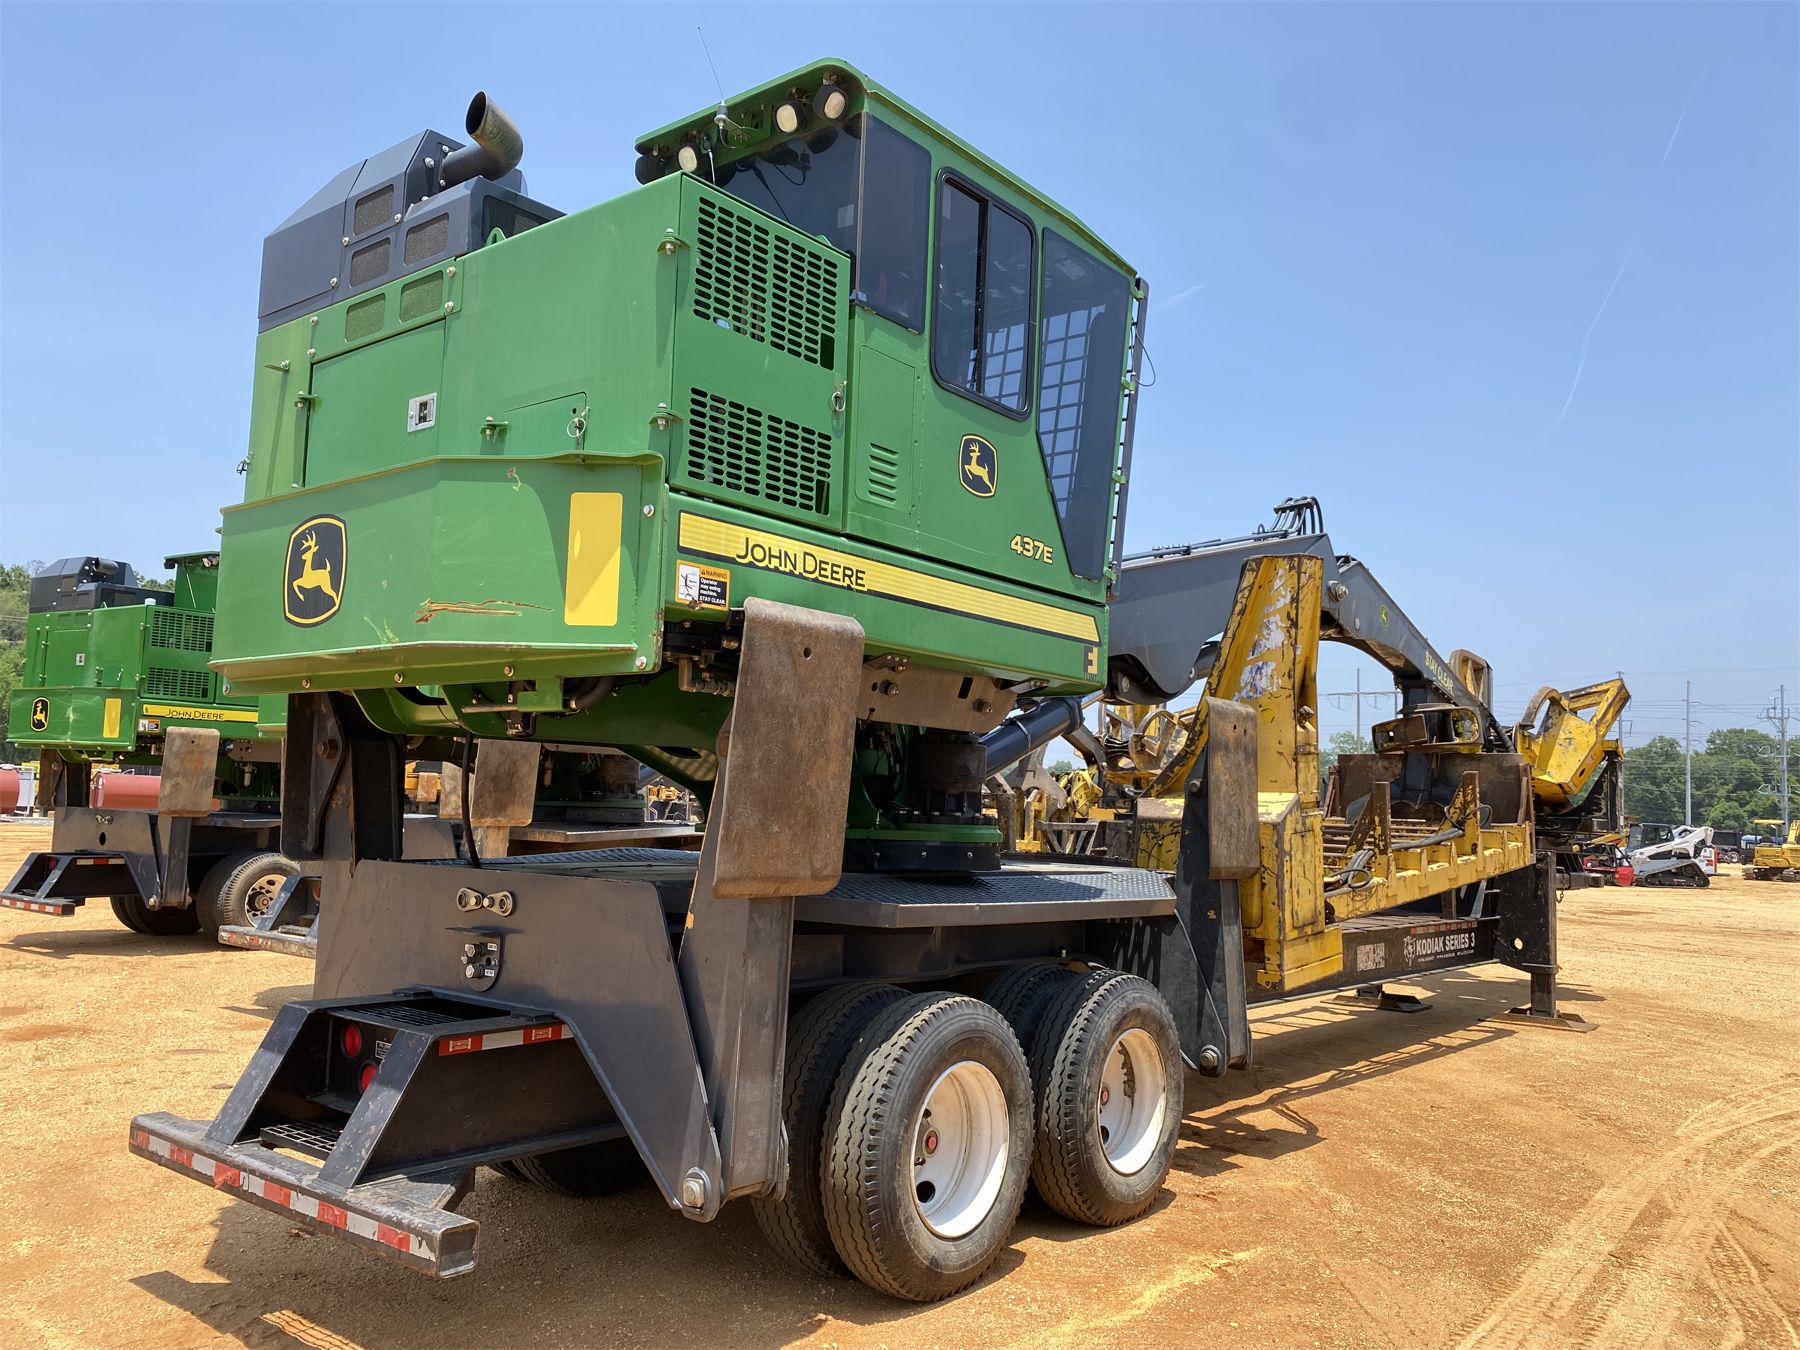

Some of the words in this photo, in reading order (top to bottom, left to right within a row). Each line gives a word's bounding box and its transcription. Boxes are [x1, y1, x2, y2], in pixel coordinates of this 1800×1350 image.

[736, 537, 797, 571] JOHN
[803, 551, 866, 588] DEERE
[1010, 533, 1053, 565] 437E
[705, 570, 728, 579] WARNING
[1425, 649, 1439, 675] STAY
[1437, 666, 1454, 697] CLEAR
[167, 708, 191, 718] JOHN
[194, 711, 224, 720] DEERE
[1416, 936, 1444, 956] KODIAK
[1445, 933, 1469, 951] SERIES
[1470, 931, 1475, 947] 3
